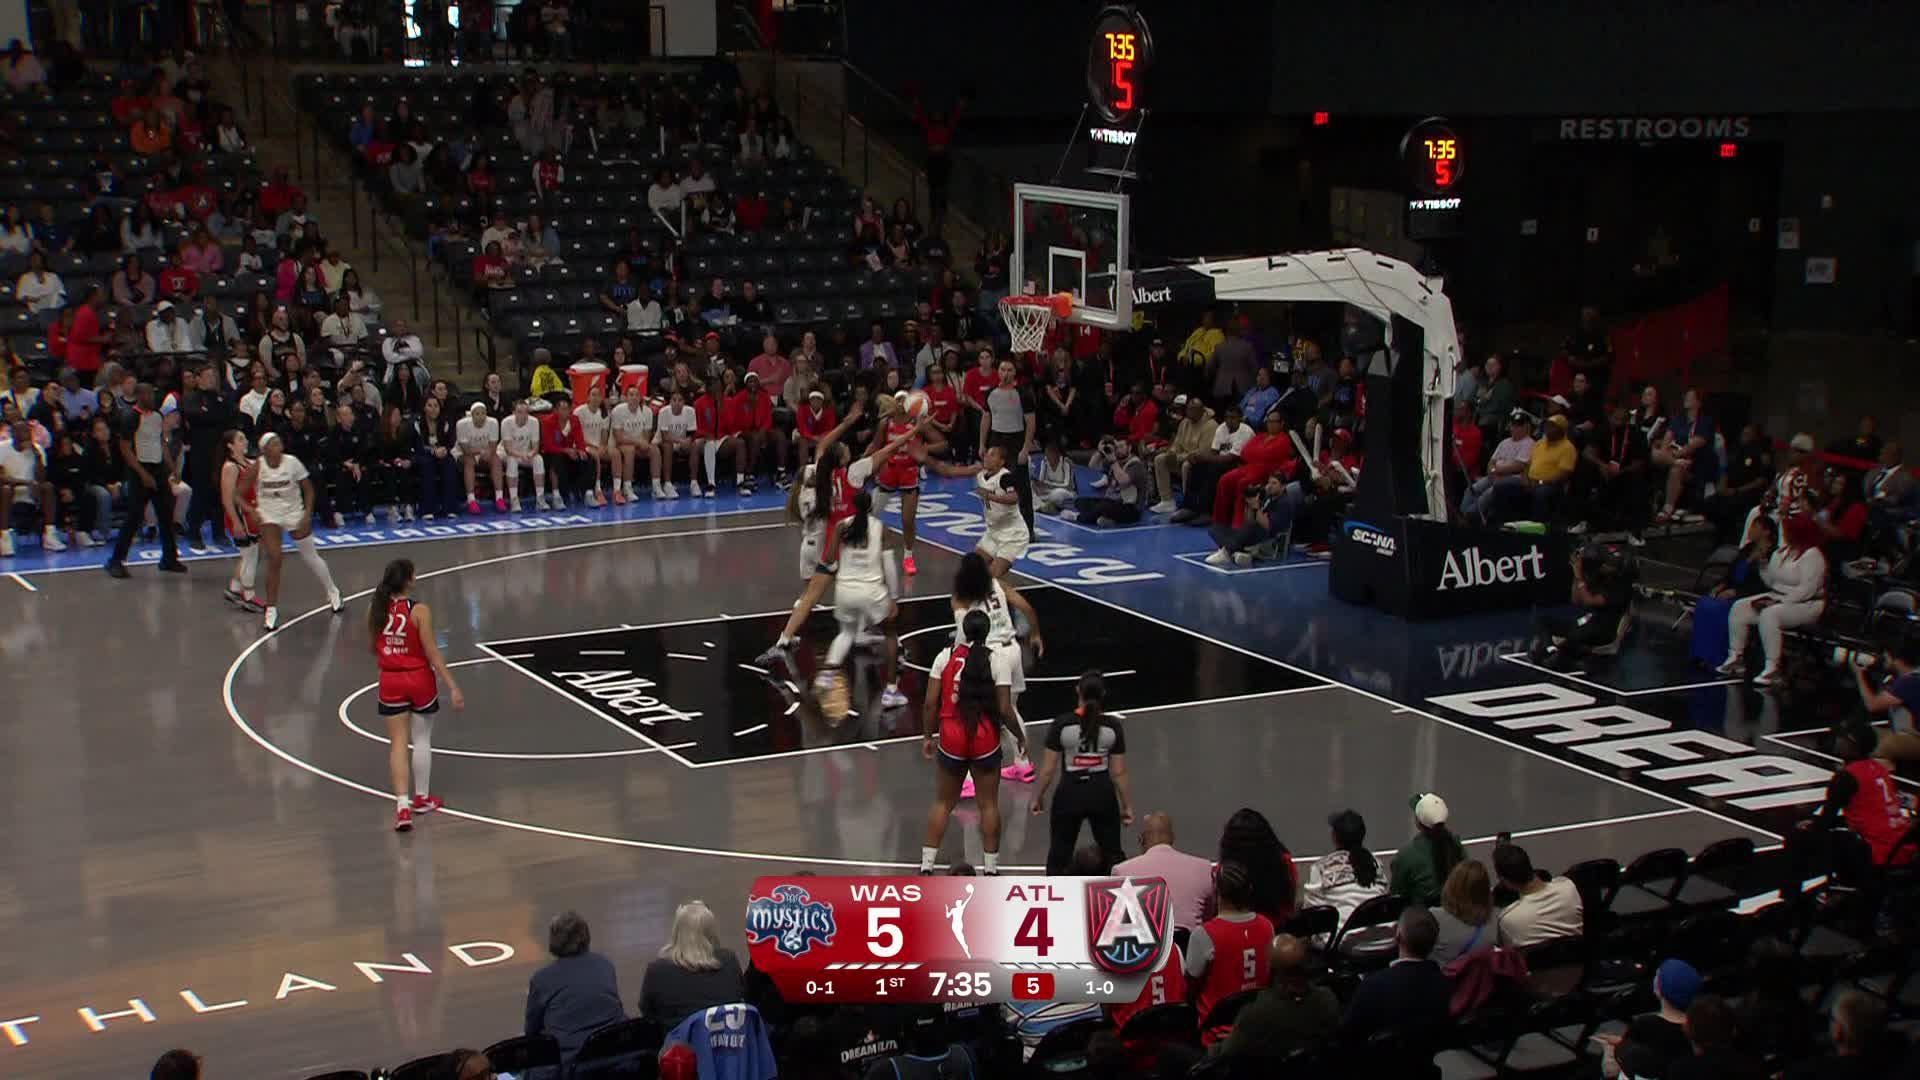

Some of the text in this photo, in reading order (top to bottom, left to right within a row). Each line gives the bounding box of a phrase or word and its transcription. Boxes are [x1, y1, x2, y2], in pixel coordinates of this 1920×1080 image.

[1105, 33, 1135, 60] 7:35
[1115, 61, 1132, 109] 5
[1102, 128, 1137, 144] TISSOT
[1559, 117, 1750, 140] RESTROOMS
[1424, 140, 1456, 160] 7:35
[1435, 160, 1449, 185] 5
[1423, 198, 1461, 210] TISSOT
[1436, 544, 1547, 591] Albert
[382, 612, 408, 637] 22
[551, 669, 704, 726] Albert
[841, 1043, 877, 1063] DREAM
